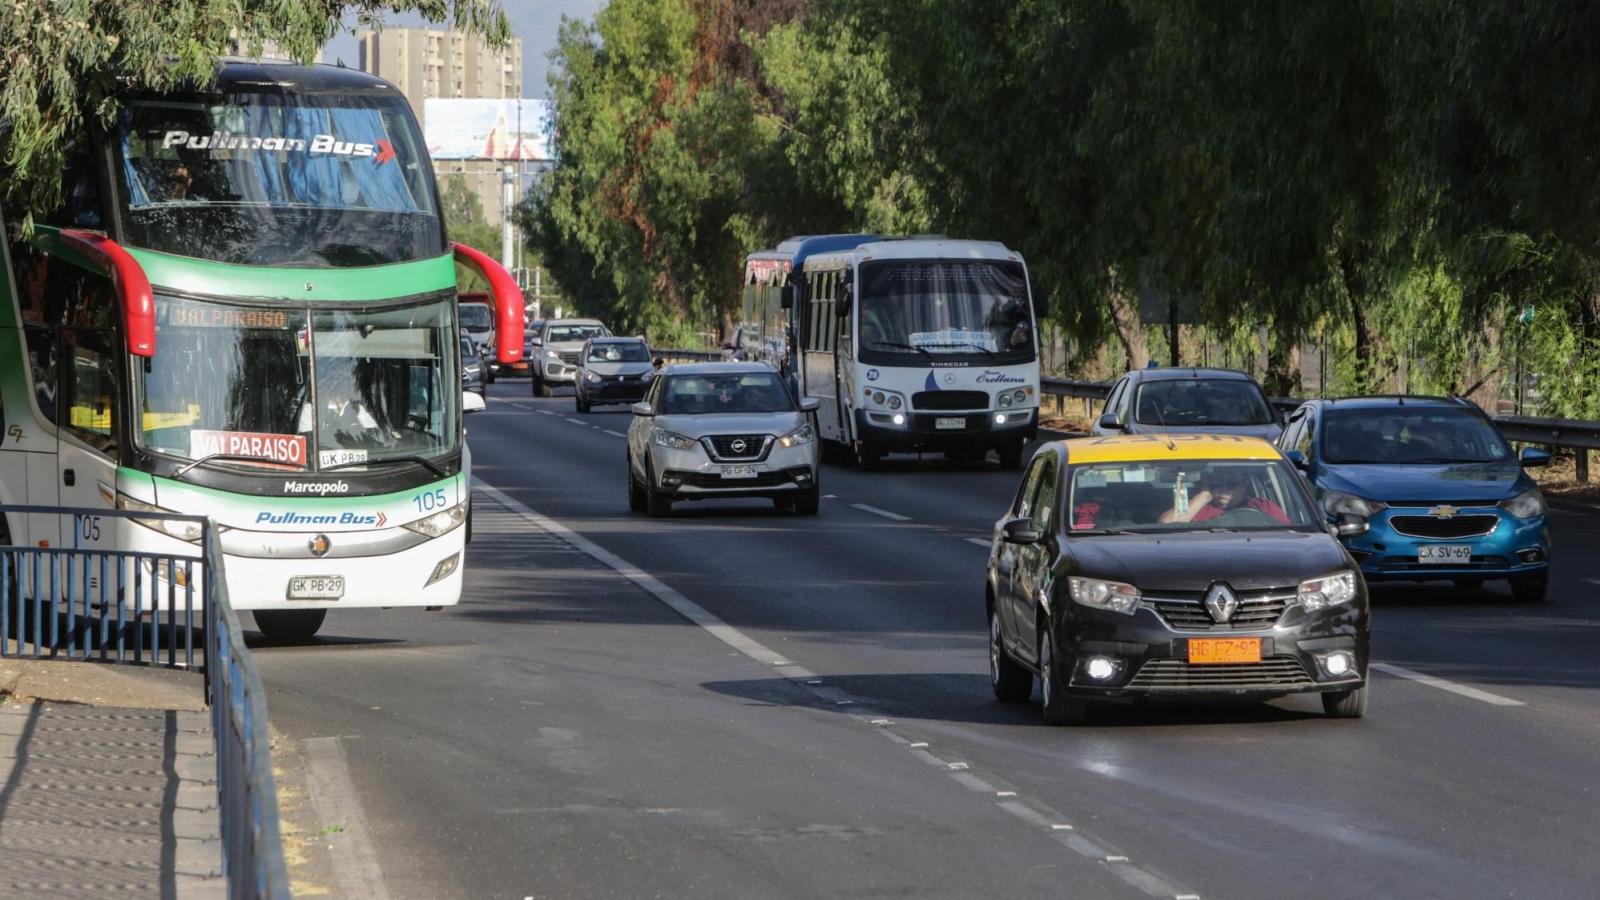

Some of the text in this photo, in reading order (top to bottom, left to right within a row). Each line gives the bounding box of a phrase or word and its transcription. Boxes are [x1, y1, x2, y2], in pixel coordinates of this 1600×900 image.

[161, 130, 377, 157] Pullman Bus
[976, 374, 1025, 384] Orellana
[284, 480, 349, 496] Marcopolo
[412, 488, 447, 513] 105
[255, 511, 377, 524] Pullman Bus
[293, 580, 307, 592] GK
